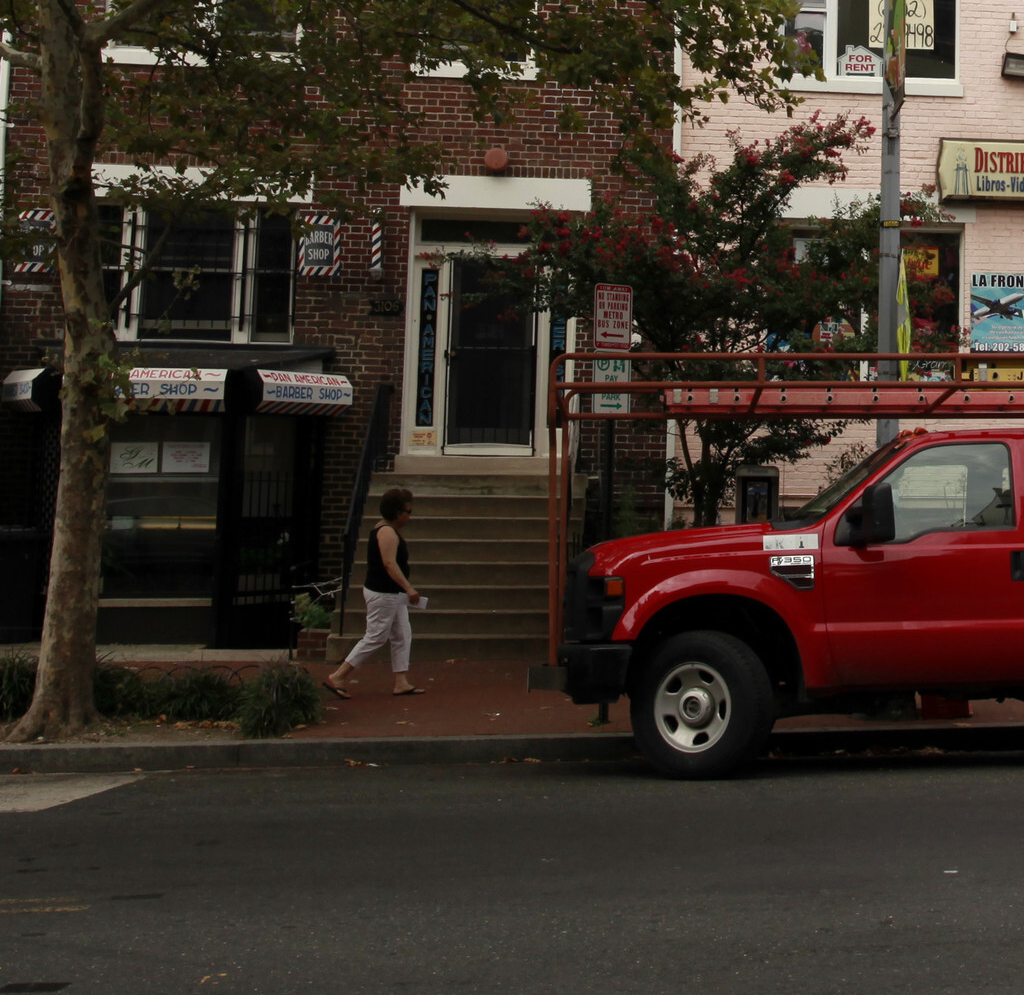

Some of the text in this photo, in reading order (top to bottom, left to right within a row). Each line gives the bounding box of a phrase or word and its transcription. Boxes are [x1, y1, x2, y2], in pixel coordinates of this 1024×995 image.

[849, 55, 873, 63] FOR
[845, 63, 876, 72] RENT
[304, 231, 333, 246] BARBER
[308, 249, 330, 260] SHOP
[972, 274, 988, 287] LA
[423, 272, 437, 311] PAN
[599, 292, 629, 302] NO STANDING
[600, 301, 628, 311] OR PARKING
[603, 310, 623, 320] METRO
[598, 319, 628, 330] BUS ZONE
[975, 342, 991, 352] Tel:
[418, 323, 435, 424] AMERICAN
[605, 374, 618, 382] PAY
[271, 373, 341, 386] PAN AMERICAN
[160, 383, 197, 396] SHOP
[276, 386, 343, 401] BARBER SHOP
